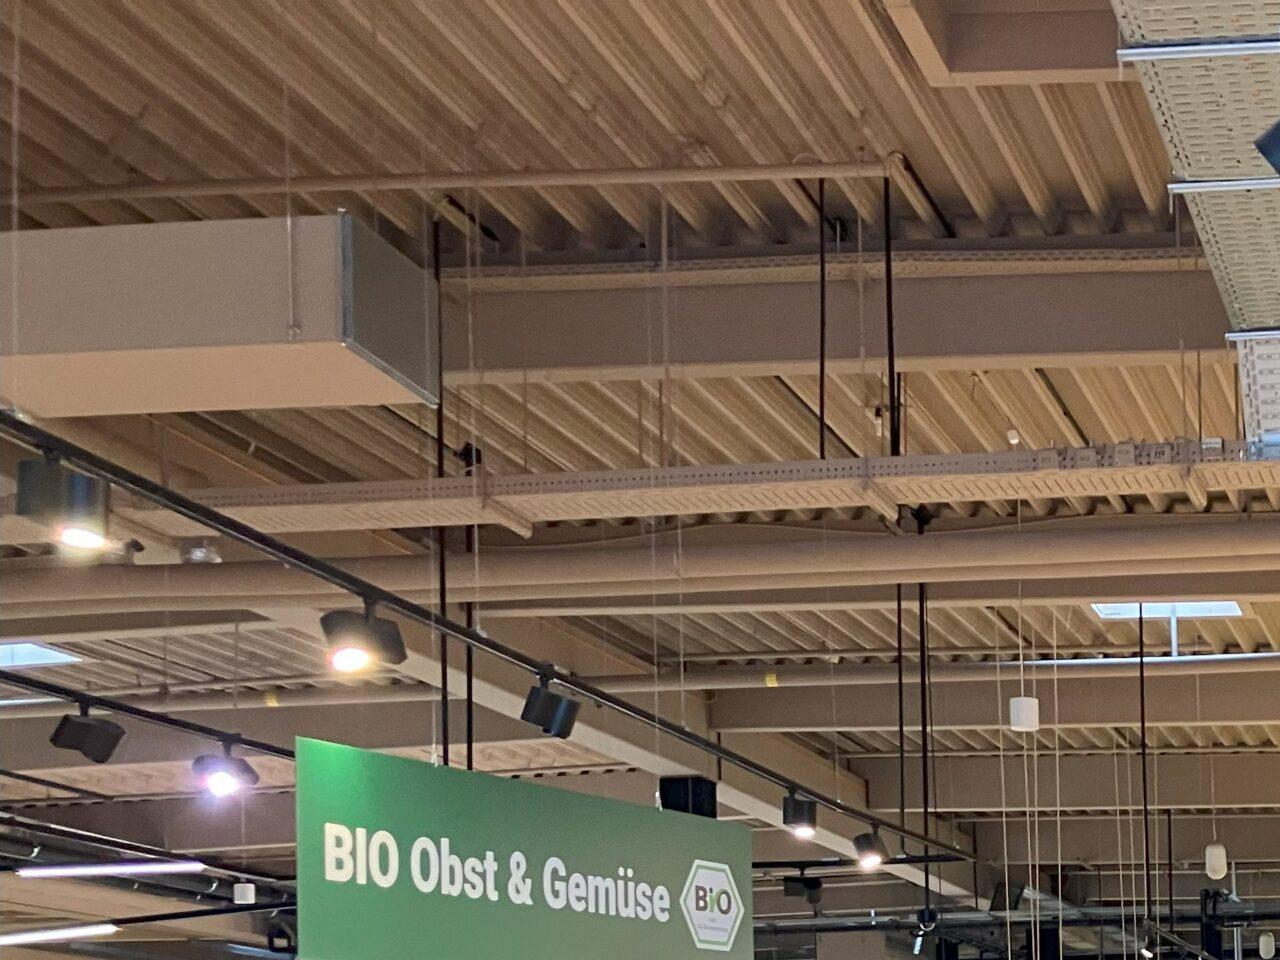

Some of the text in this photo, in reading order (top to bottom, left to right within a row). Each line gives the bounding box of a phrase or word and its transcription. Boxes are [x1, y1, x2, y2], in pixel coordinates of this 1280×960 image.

[323, 822, 671, 923] BIO Obst & Gemüse
